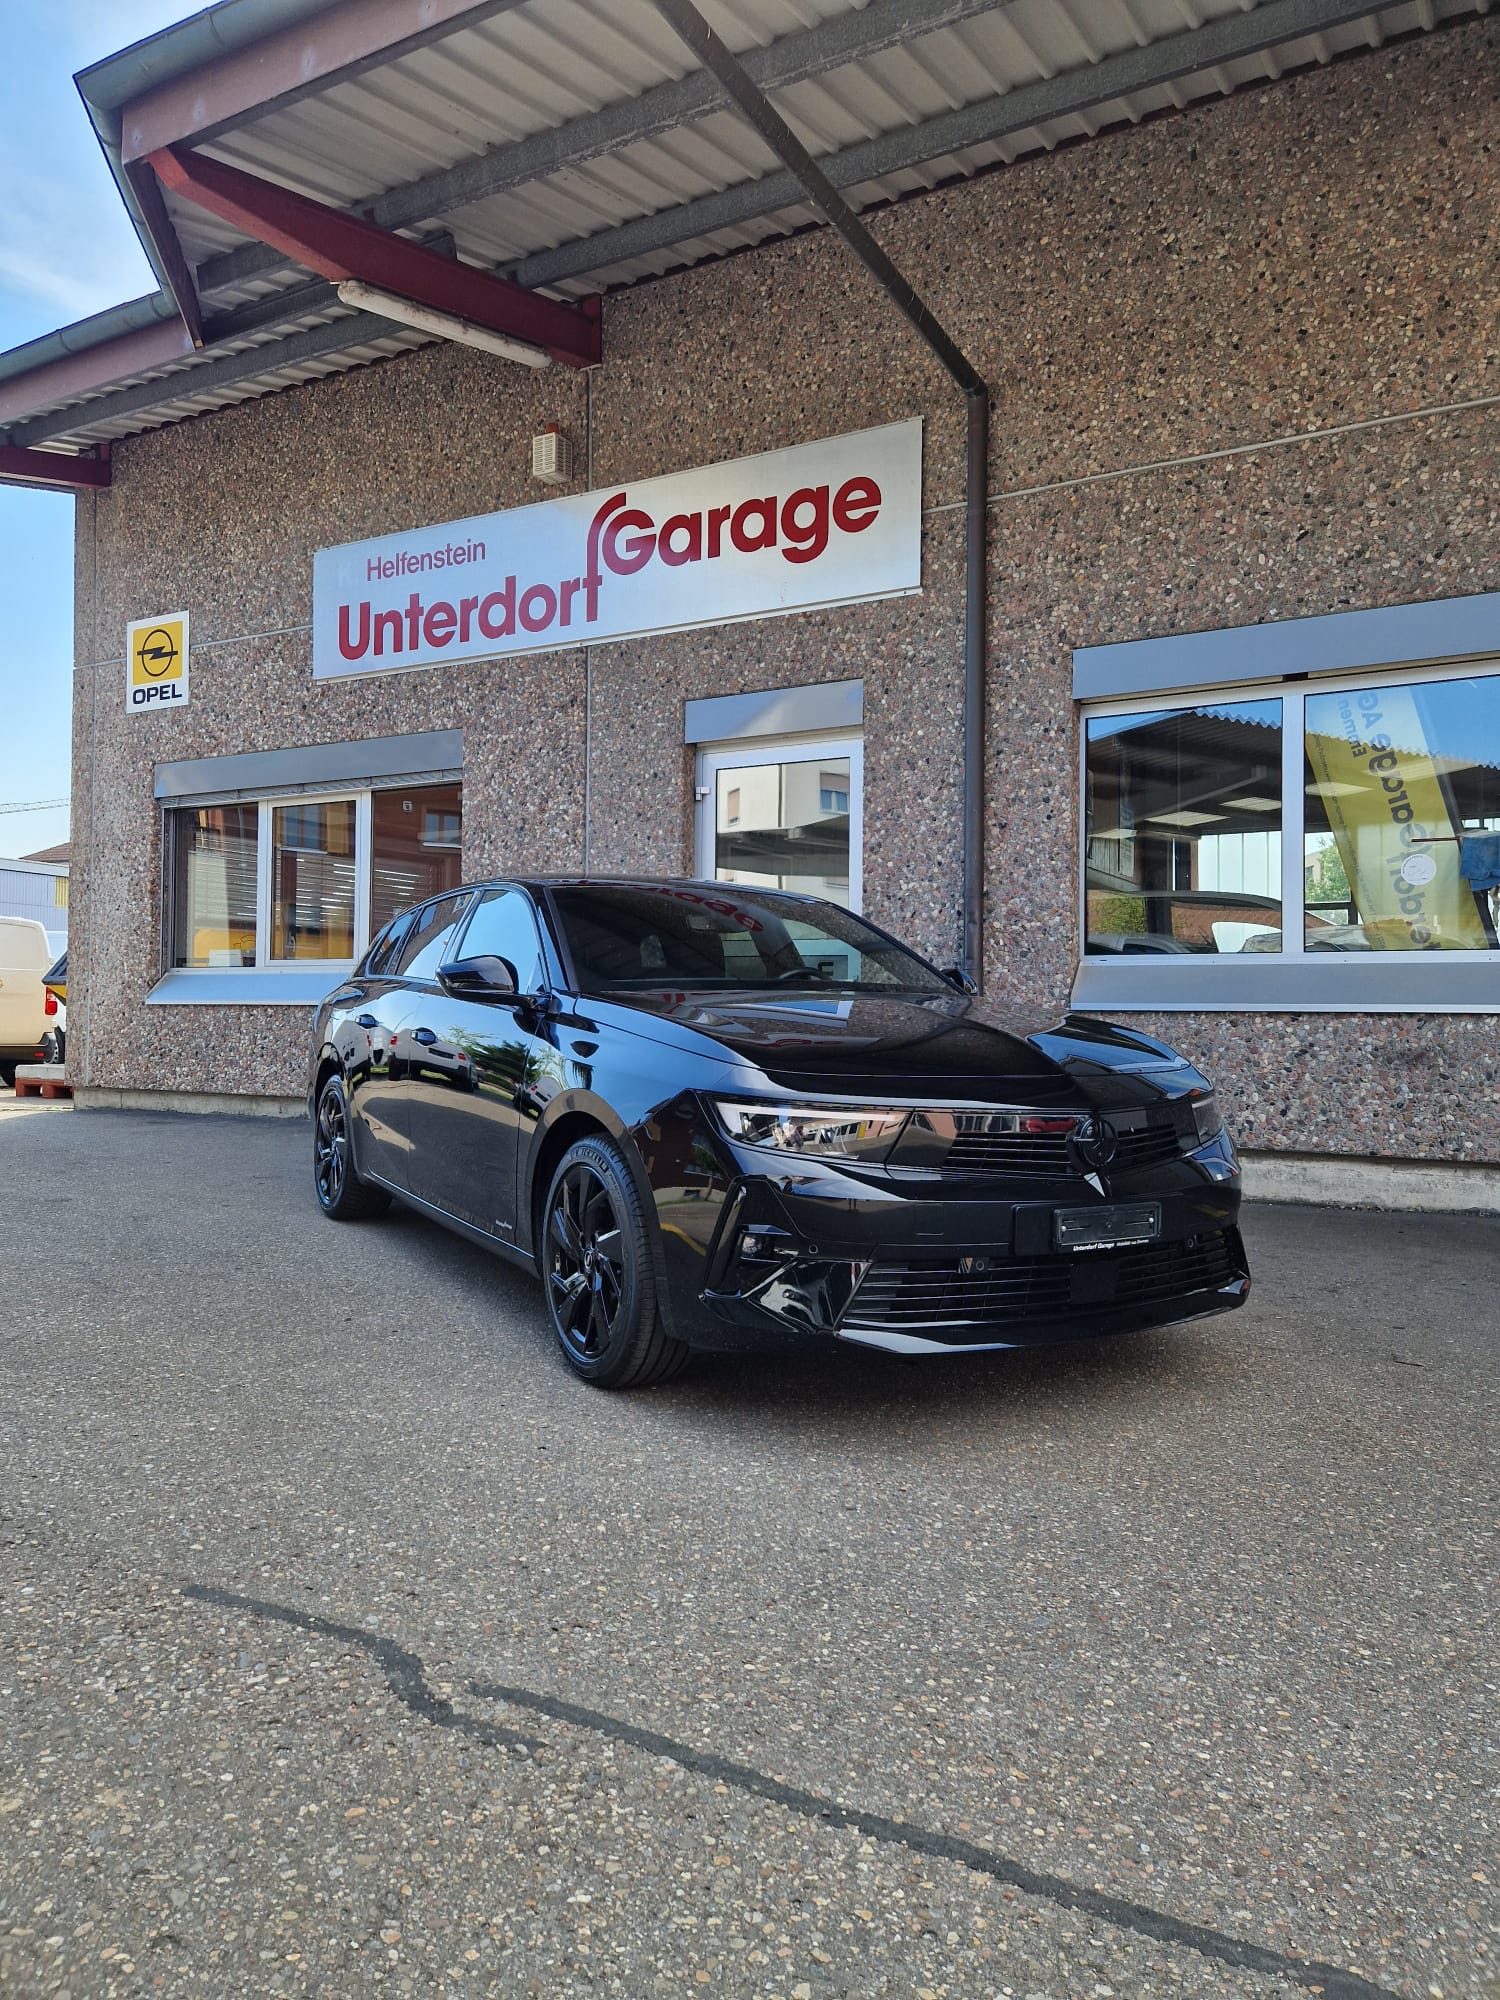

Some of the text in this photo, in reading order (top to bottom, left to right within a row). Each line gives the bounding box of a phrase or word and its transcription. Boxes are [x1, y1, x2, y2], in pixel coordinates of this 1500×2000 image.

[338, 476, 882, 660] Unterdorf Garage
[366, 538, 486, 582] Helfenstein
[132, 683, 183, 705] OPEL
